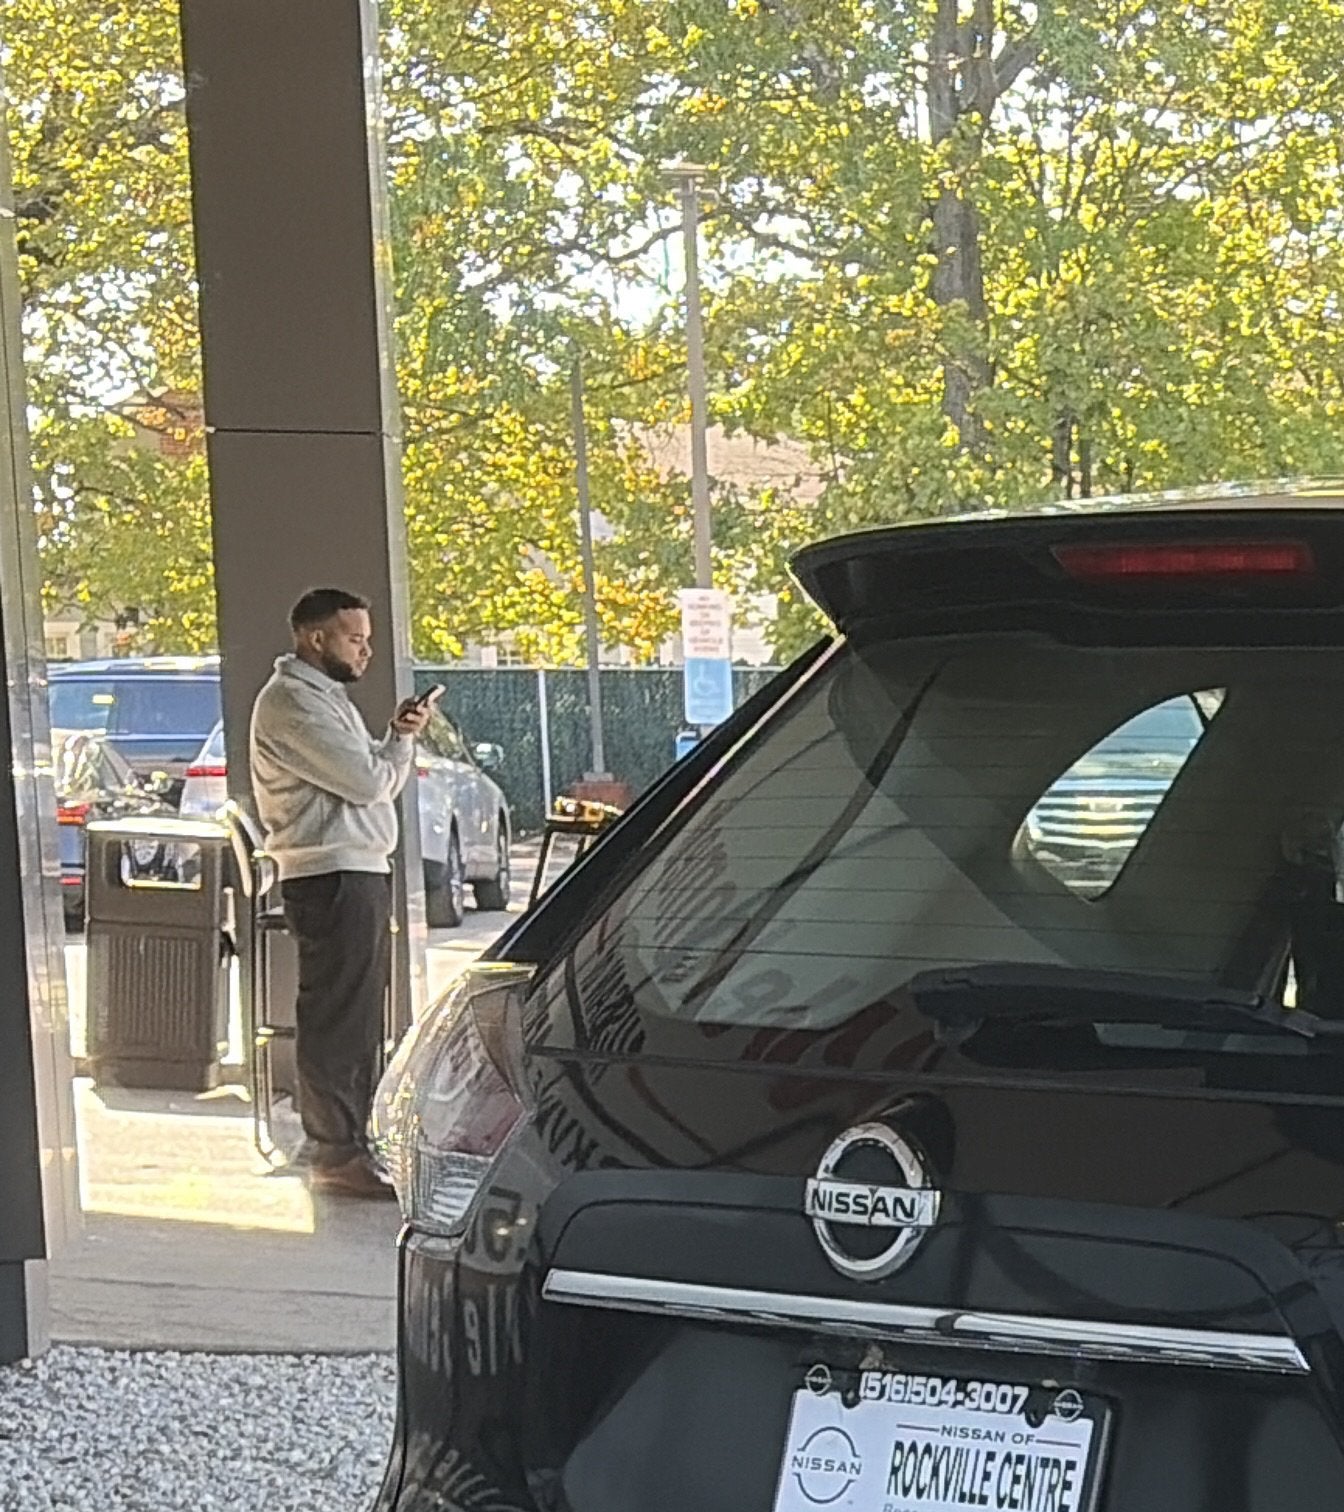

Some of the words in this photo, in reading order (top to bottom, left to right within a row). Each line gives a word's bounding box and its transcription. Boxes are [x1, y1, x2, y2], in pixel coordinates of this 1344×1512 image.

[811, 1187, 916, 1220] NISSAN
[858, 1371, 1030, 1416] (516)504-3007
[940, 1424, 1006, 1444] NISSAN
[1011, 1432, 1036, 1446] OF
[791, 1454, 863, 1476] NISSAN
[886, 1439, 997, 1506] ROCKVILLE
